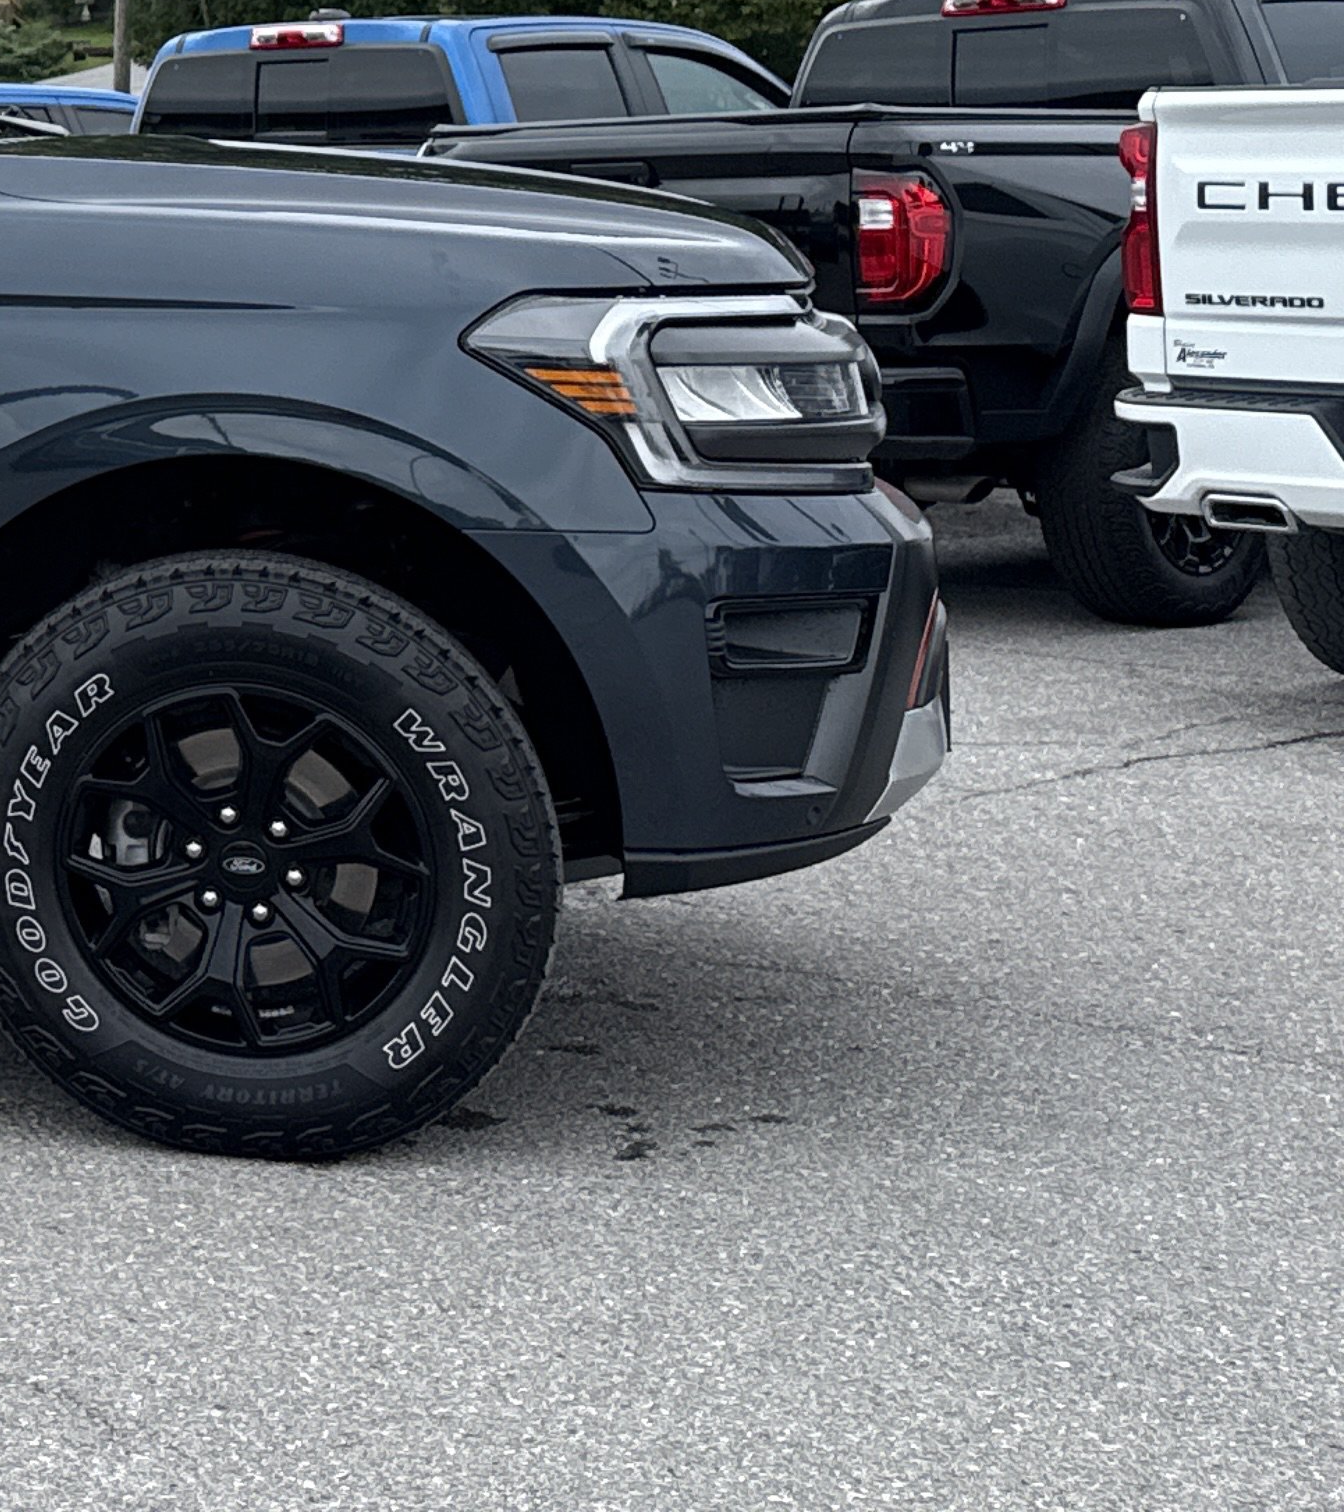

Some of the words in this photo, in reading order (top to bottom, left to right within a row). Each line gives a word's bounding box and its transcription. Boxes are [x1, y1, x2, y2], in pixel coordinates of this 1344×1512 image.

[1185, 293, 1325, 309] SILVERADO
[4, 673, 115, 1032] GOODYEAR
[382, 708, 492, 1070] WRANGLER
